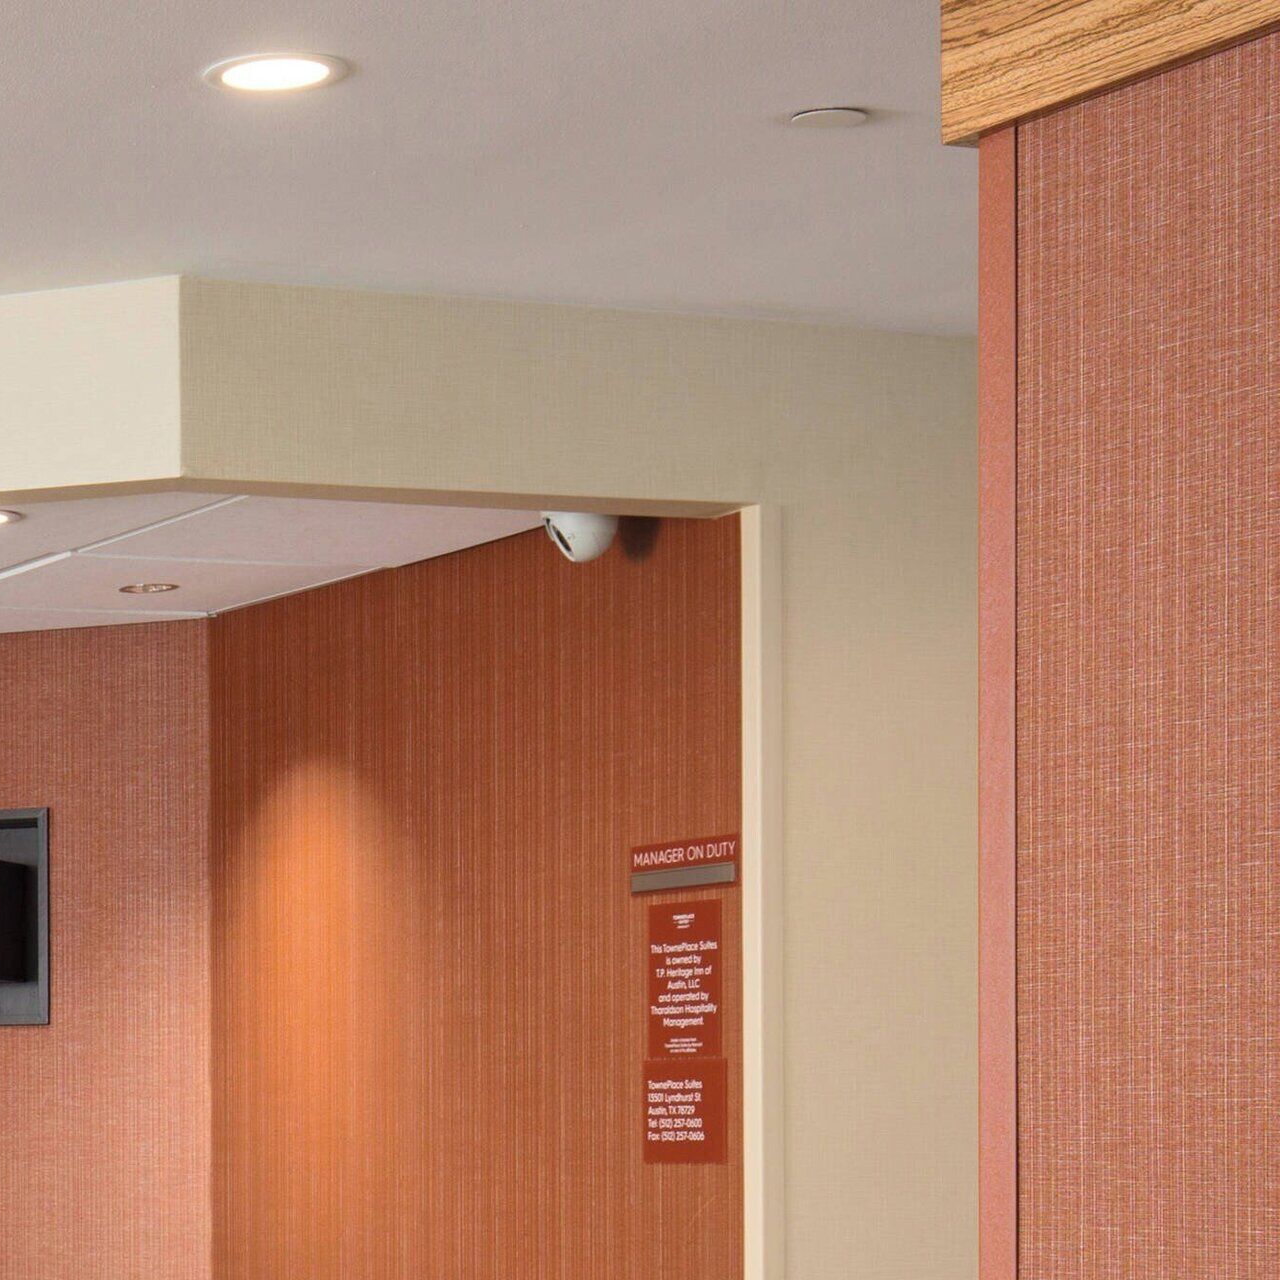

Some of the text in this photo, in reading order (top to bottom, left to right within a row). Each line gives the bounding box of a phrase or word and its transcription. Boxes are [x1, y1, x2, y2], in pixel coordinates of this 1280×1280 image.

[633, 841, 736, 867] MANAGER ON DUTY
[699, 940, 718, 950] Suites
[705, 965, 712, 975] of
